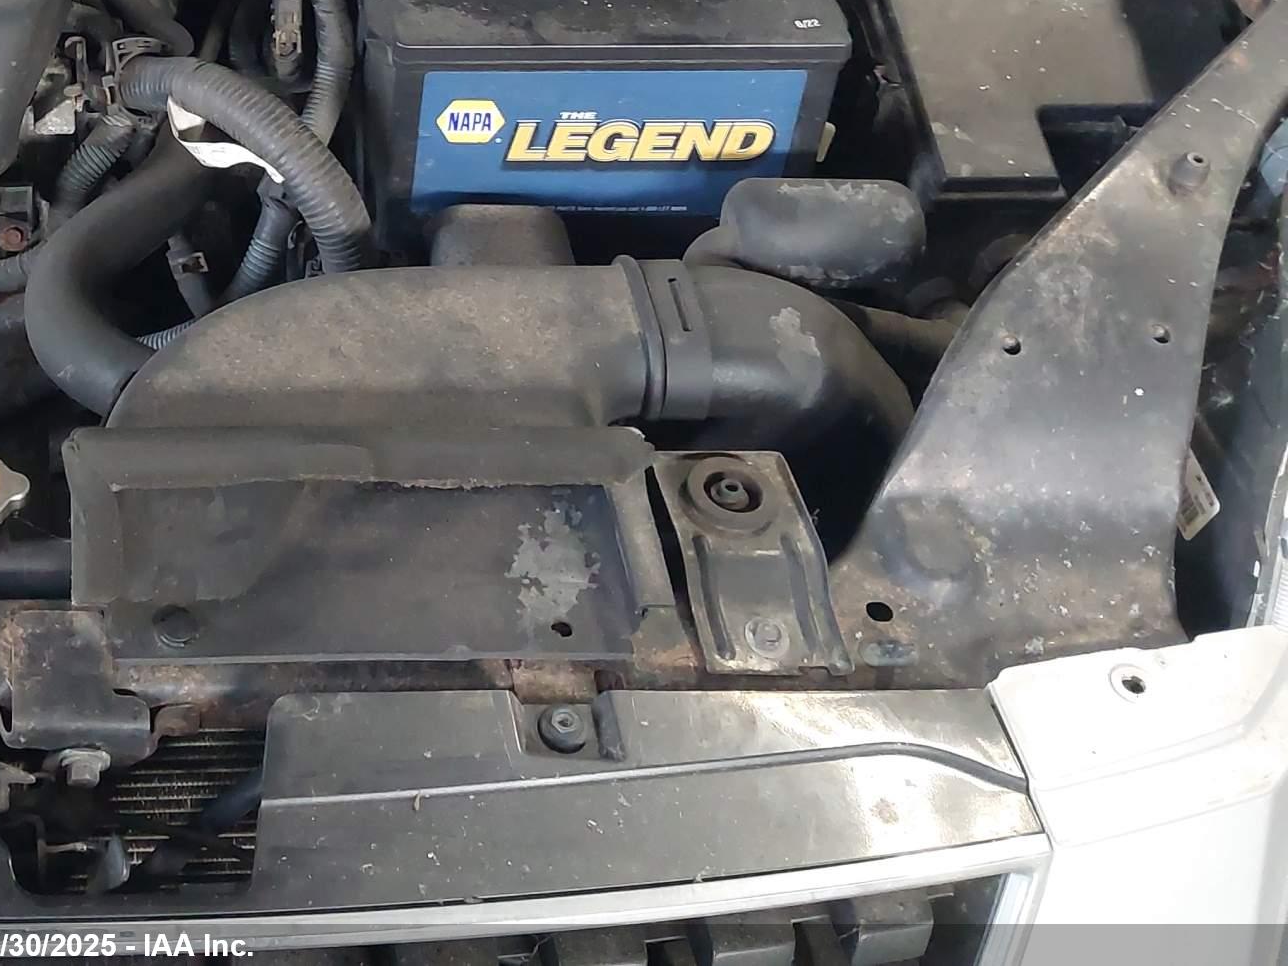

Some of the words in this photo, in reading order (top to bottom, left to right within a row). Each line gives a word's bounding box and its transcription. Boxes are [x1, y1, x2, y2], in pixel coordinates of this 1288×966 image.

[448, 111, 492, 132] NAPA
[560, 111, 598, 121] THE
[506, 118, 775, 162] LEGEND
